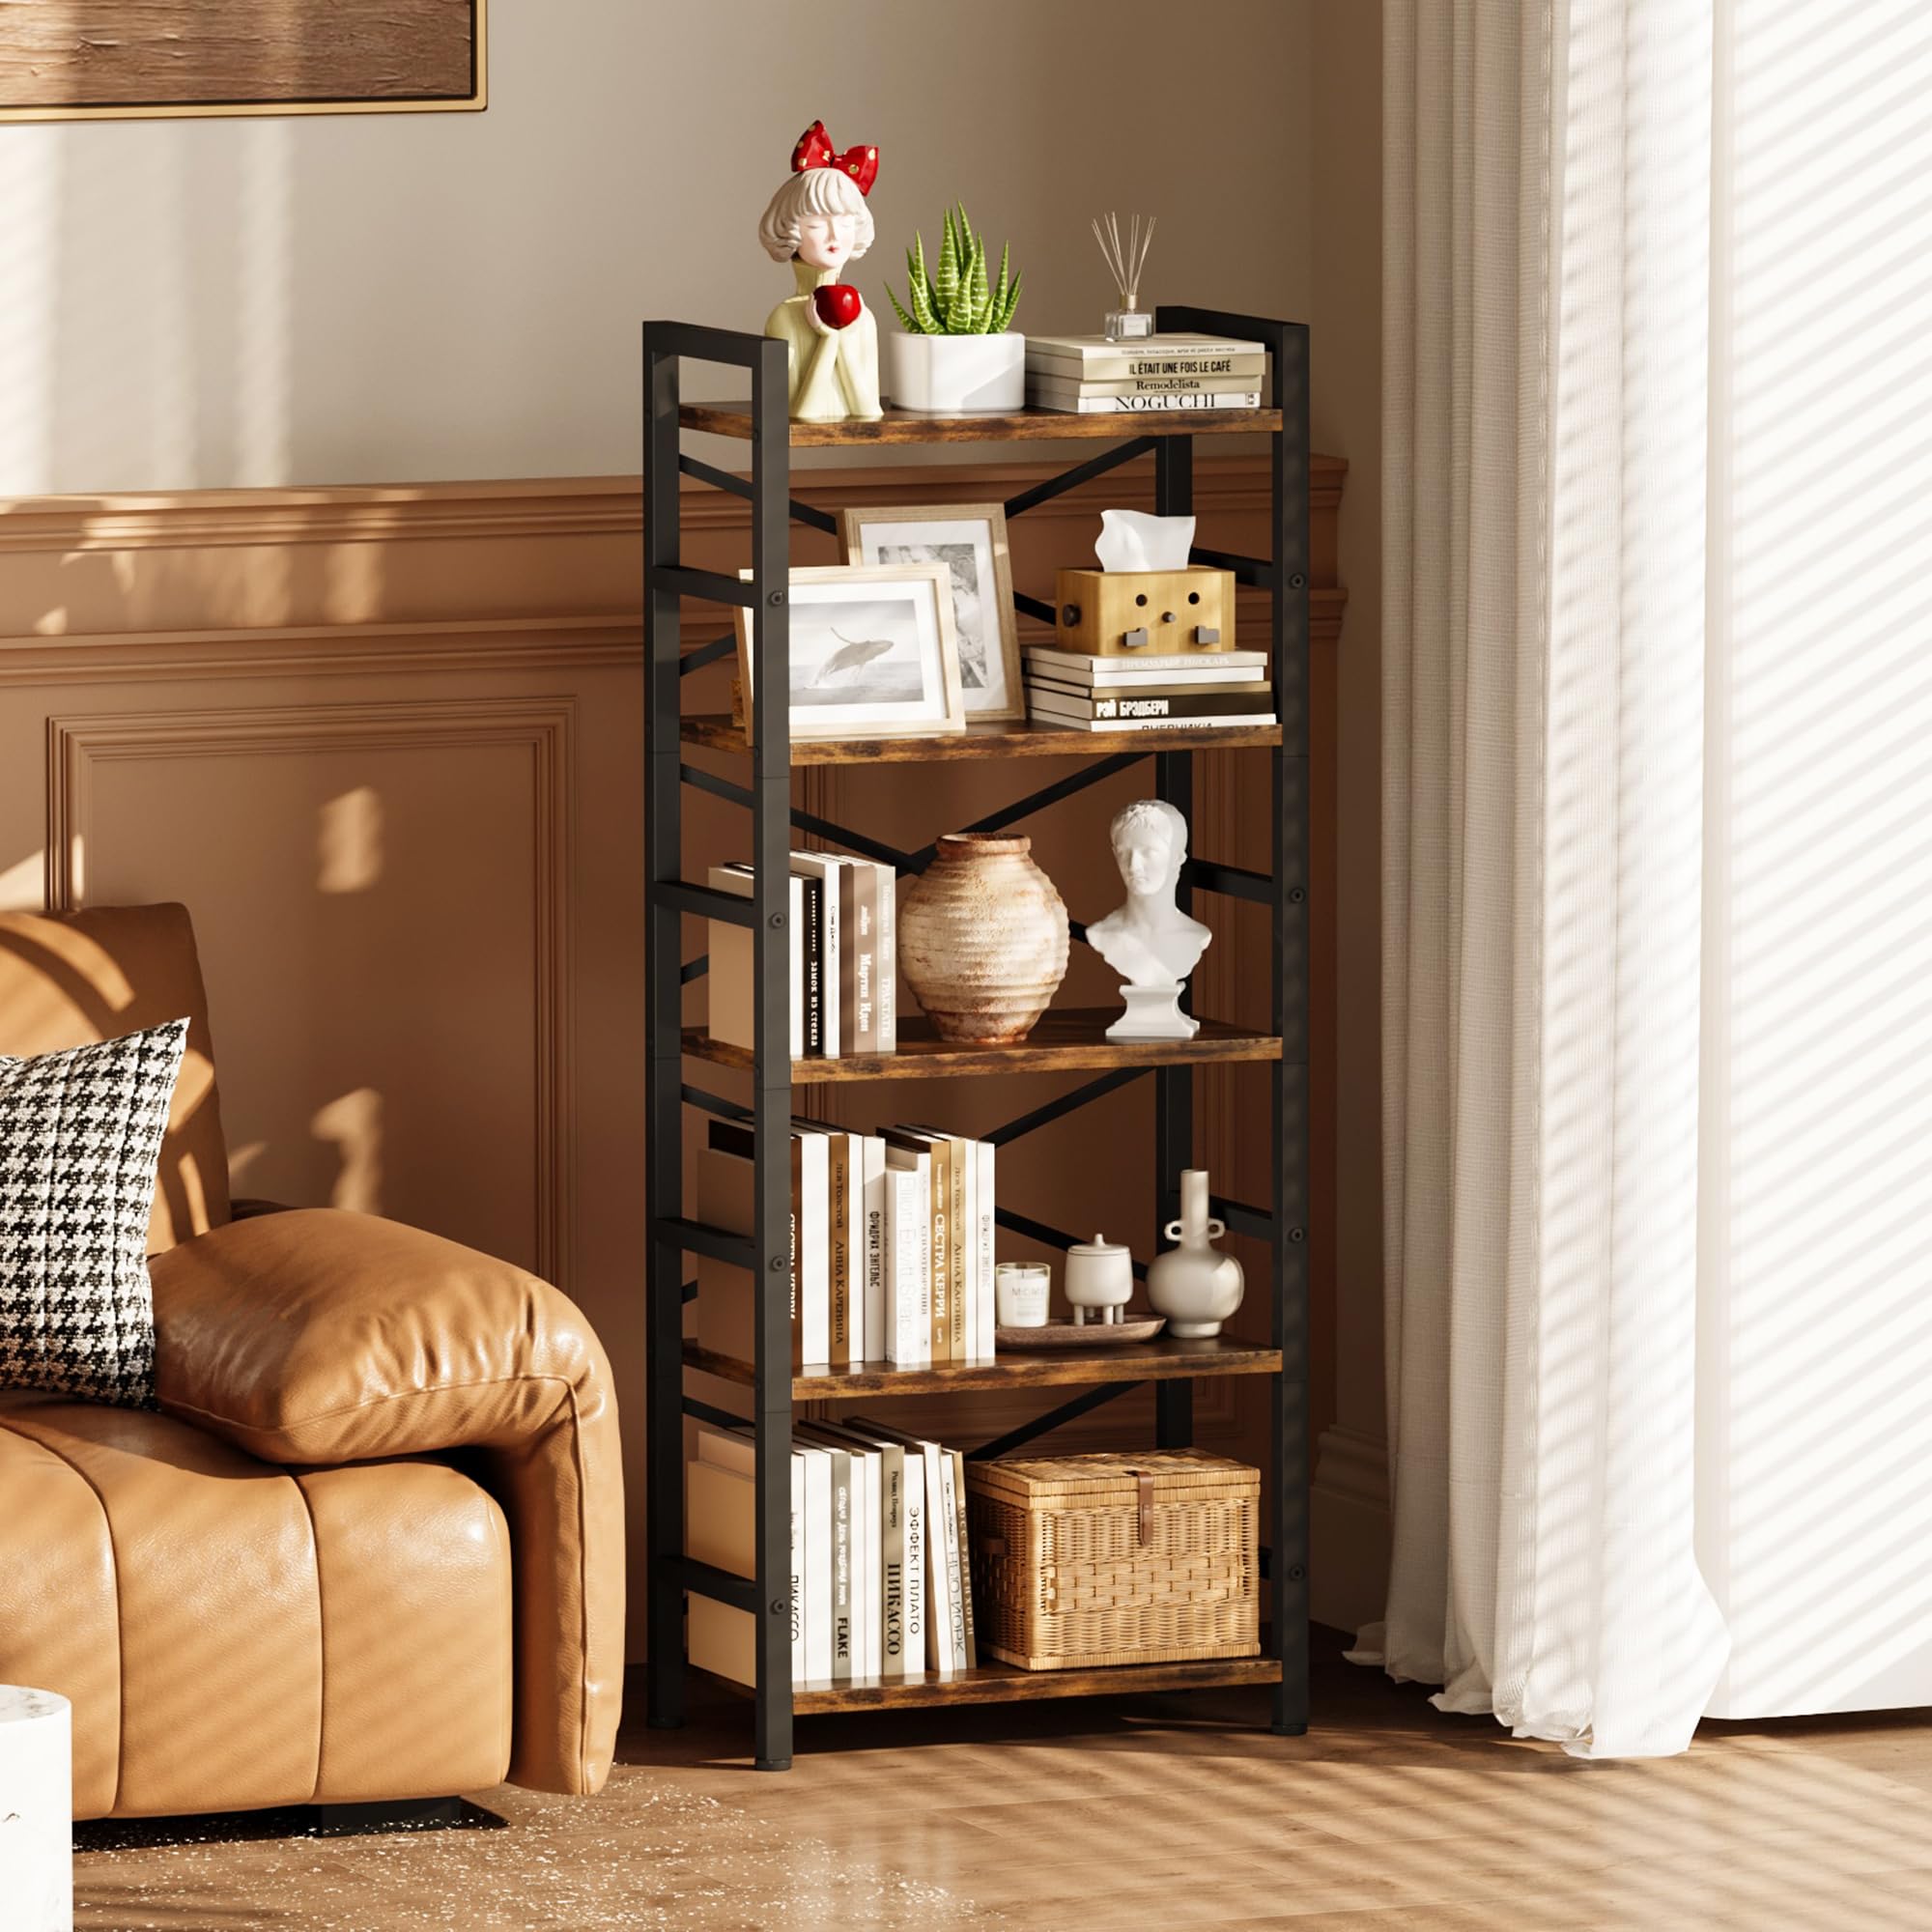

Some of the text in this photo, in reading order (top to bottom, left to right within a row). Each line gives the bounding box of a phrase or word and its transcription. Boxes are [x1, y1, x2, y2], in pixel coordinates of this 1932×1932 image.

[1128, 359, 1231, 375] IL ÉTAIT UNE FOIS LE CAFÉ
[1136, 380, 1200, 391] Remodelista
[1115, 393, 1215, 412] NOGUCHI
[857, 953, 871, 1033] Мартин Иден
[867, 1210, 880, 1287] ФРИДРИХ ЭНГЕЛЬС
[934, 1213, 946, 1268] СЕСТРА
[934, 1272, 946, 1319] КЕРРИ
[908, 1507, 921, 1635] ЭФФЕКТ ПЛАТО
[887, 1563, 901, 1656] ПИКАССО
[837, 1617, 848, 1659] FLAKE
